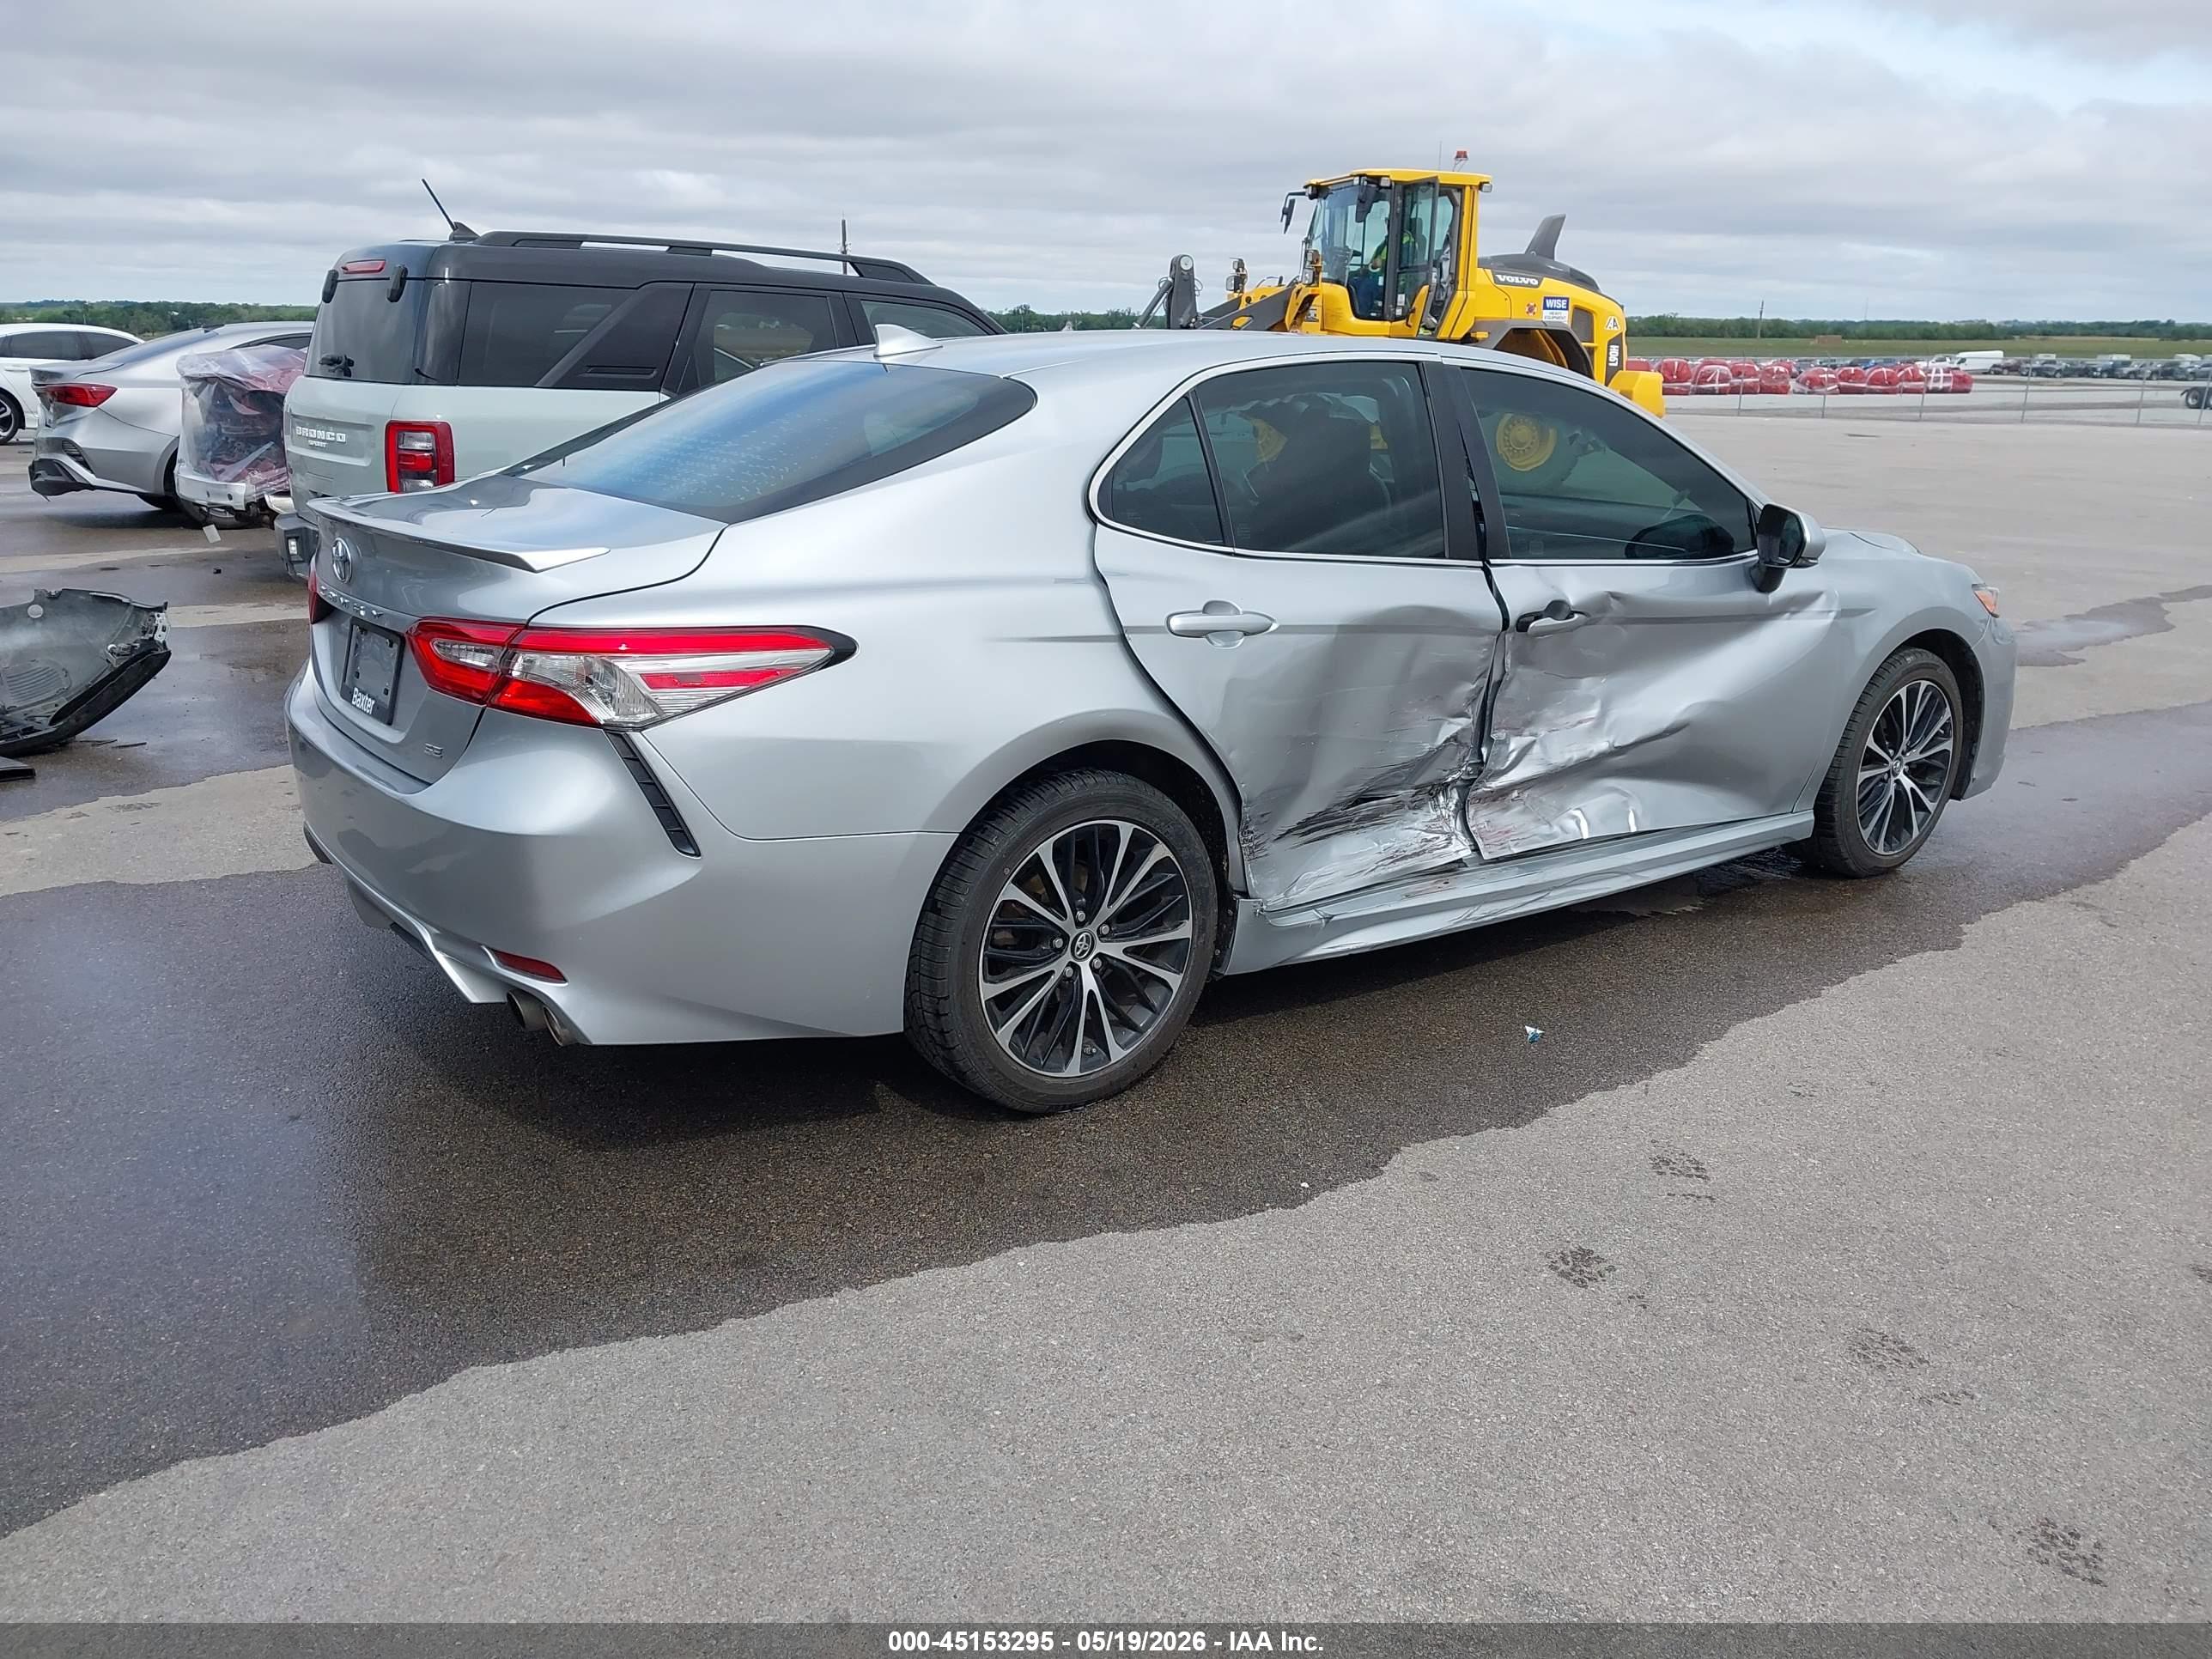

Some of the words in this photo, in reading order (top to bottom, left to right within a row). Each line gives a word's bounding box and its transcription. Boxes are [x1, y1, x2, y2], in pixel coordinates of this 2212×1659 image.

[1495, 274, 1539, 285] VOLVO
[1546, 299, 1567, 309] WISE
[295, 426, 346, 443] BRONCO
[351, 687, 375, 715] Baxter
